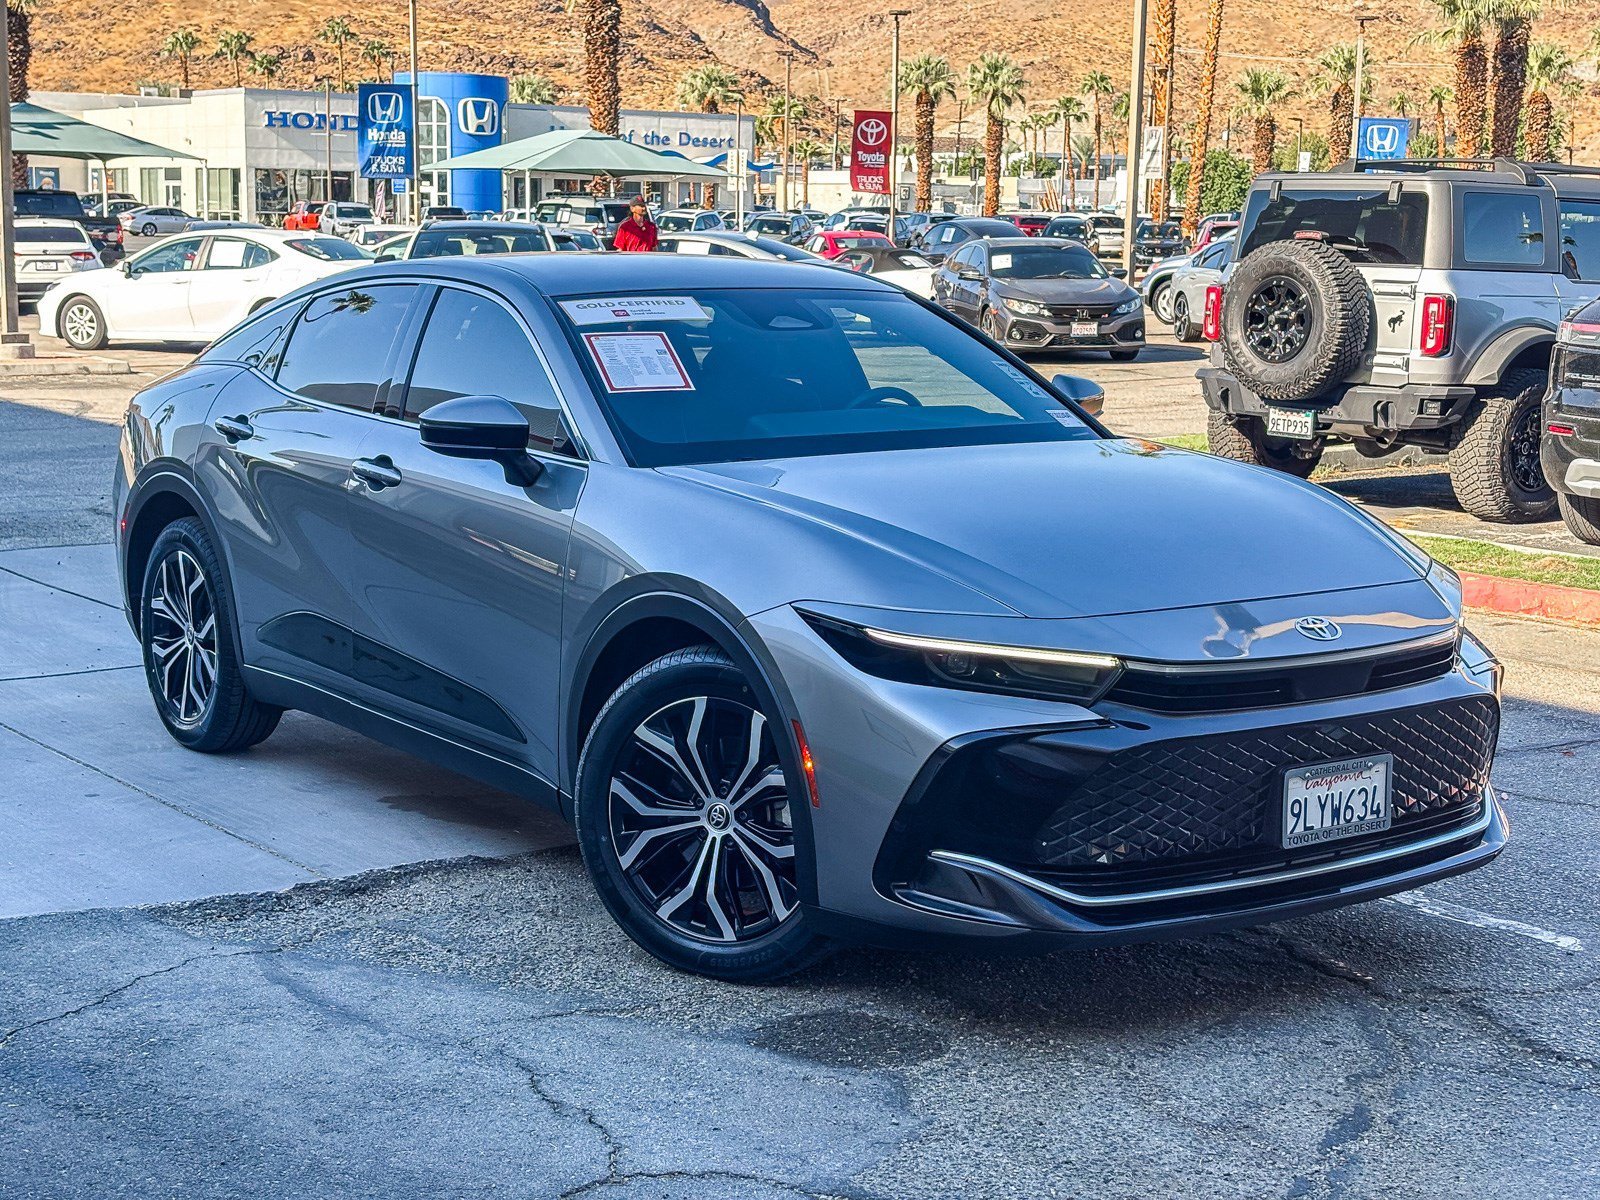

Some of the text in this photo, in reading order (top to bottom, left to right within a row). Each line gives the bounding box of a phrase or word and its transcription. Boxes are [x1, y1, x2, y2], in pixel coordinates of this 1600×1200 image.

[264, 110, 359, 131] HOND
[367, 128, 406, 141] Honda
[619, 129, 735, 149] of the Desert
[369, 155, 406, 165] TRUCKS
[857, 151, 885, 162] Toyota
[856, 175, 884, 184] TRUCKS
[576, 301, 616, 310] GOLD
[1270, 417, 1309, 434] 9ETP935
[1310, 760, 1368, 777] CATHEDRAL CITY
[1305, 770, 1372, 791] California
[1290, 784, 1381, 834] 9LYW634
[1287, 819, 1387, 847] TOYOTA OF THE DESERT
